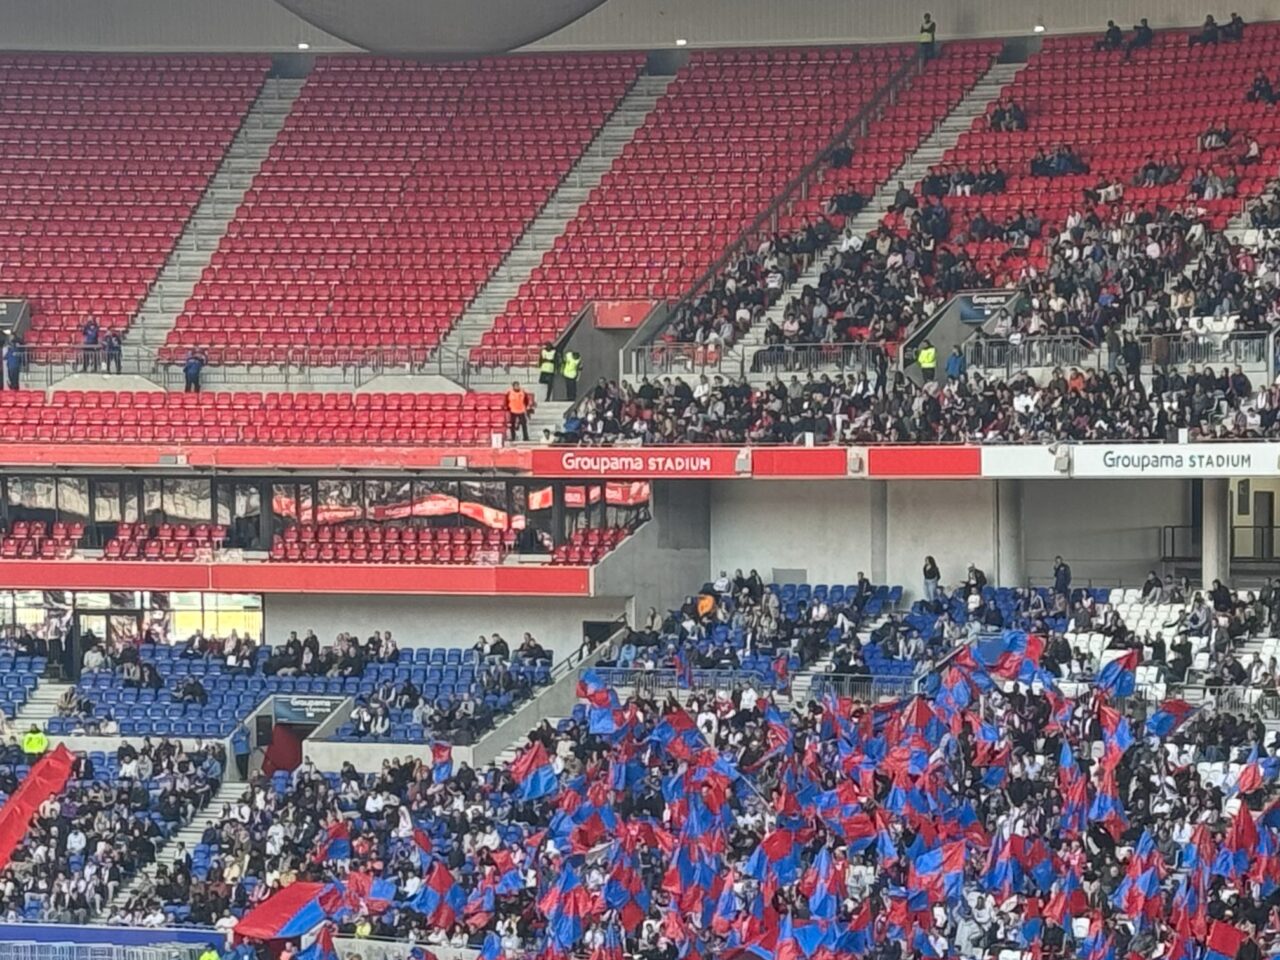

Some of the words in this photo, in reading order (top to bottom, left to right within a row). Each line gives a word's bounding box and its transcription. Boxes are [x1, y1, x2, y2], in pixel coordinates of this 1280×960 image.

[562, 452, 643, 474] Groupama
[648, 456, 711, 471] STADIUM
[1103, 450, 1184, 471] Groupama
[1188, 454, 1252, 468] STADIUM
